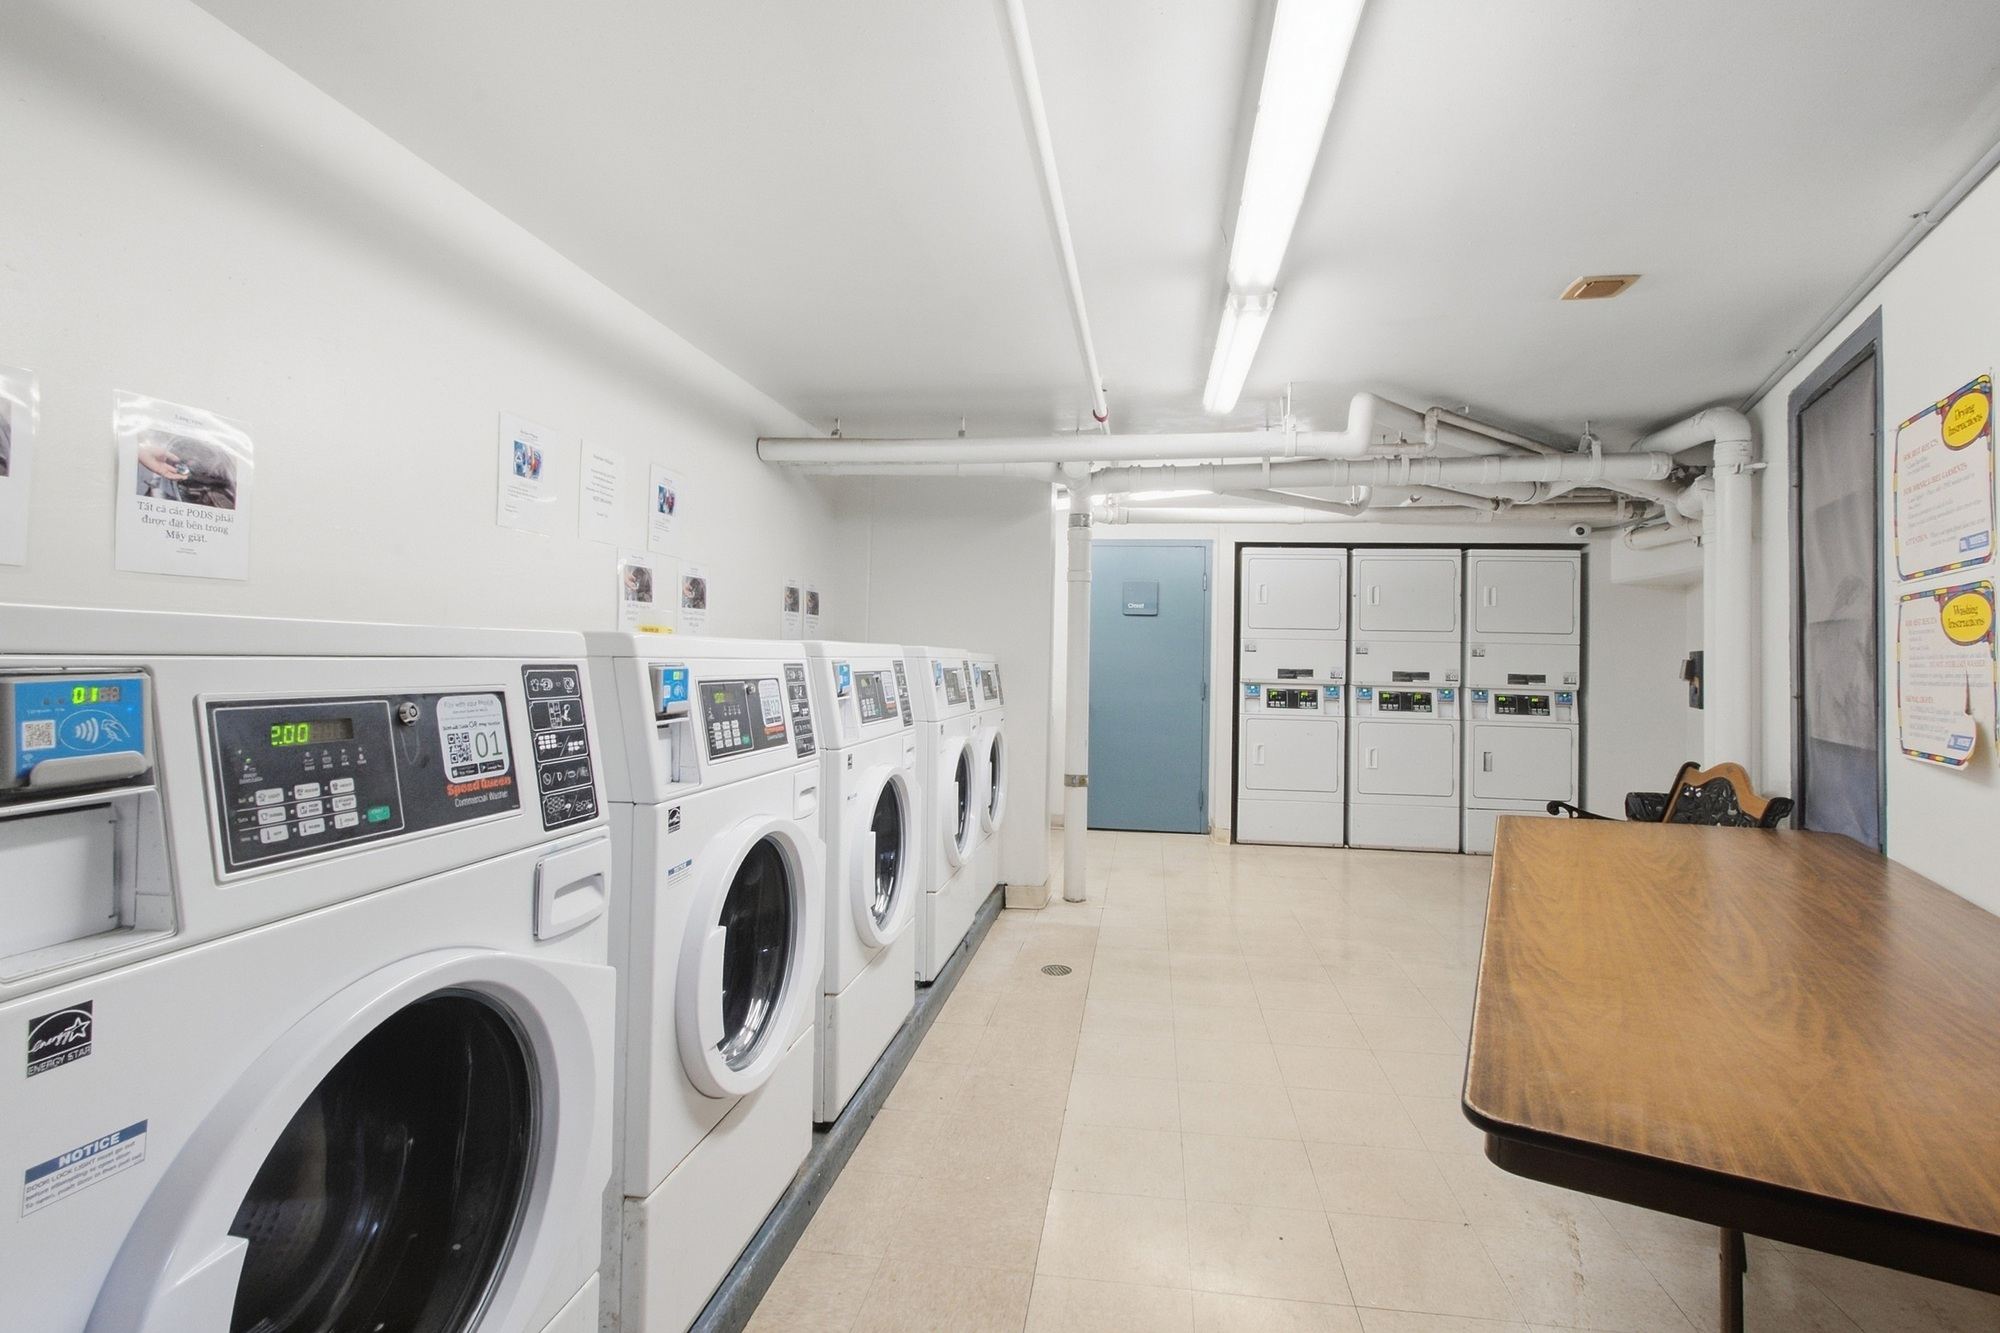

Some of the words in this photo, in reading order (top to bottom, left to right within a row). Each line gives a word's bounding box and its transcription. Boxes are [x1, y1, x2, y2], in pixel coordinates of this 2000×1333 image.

[187, 508, 213, 520] PODS
[475, 731, 503, 758] 01
[447, 781, 480, 797] Speed
[28, 1055, 65, 1076] ENERGY
[67, 1046, 91, 1061] STAR
[59, 1132, 120, 1168] NOTICE
